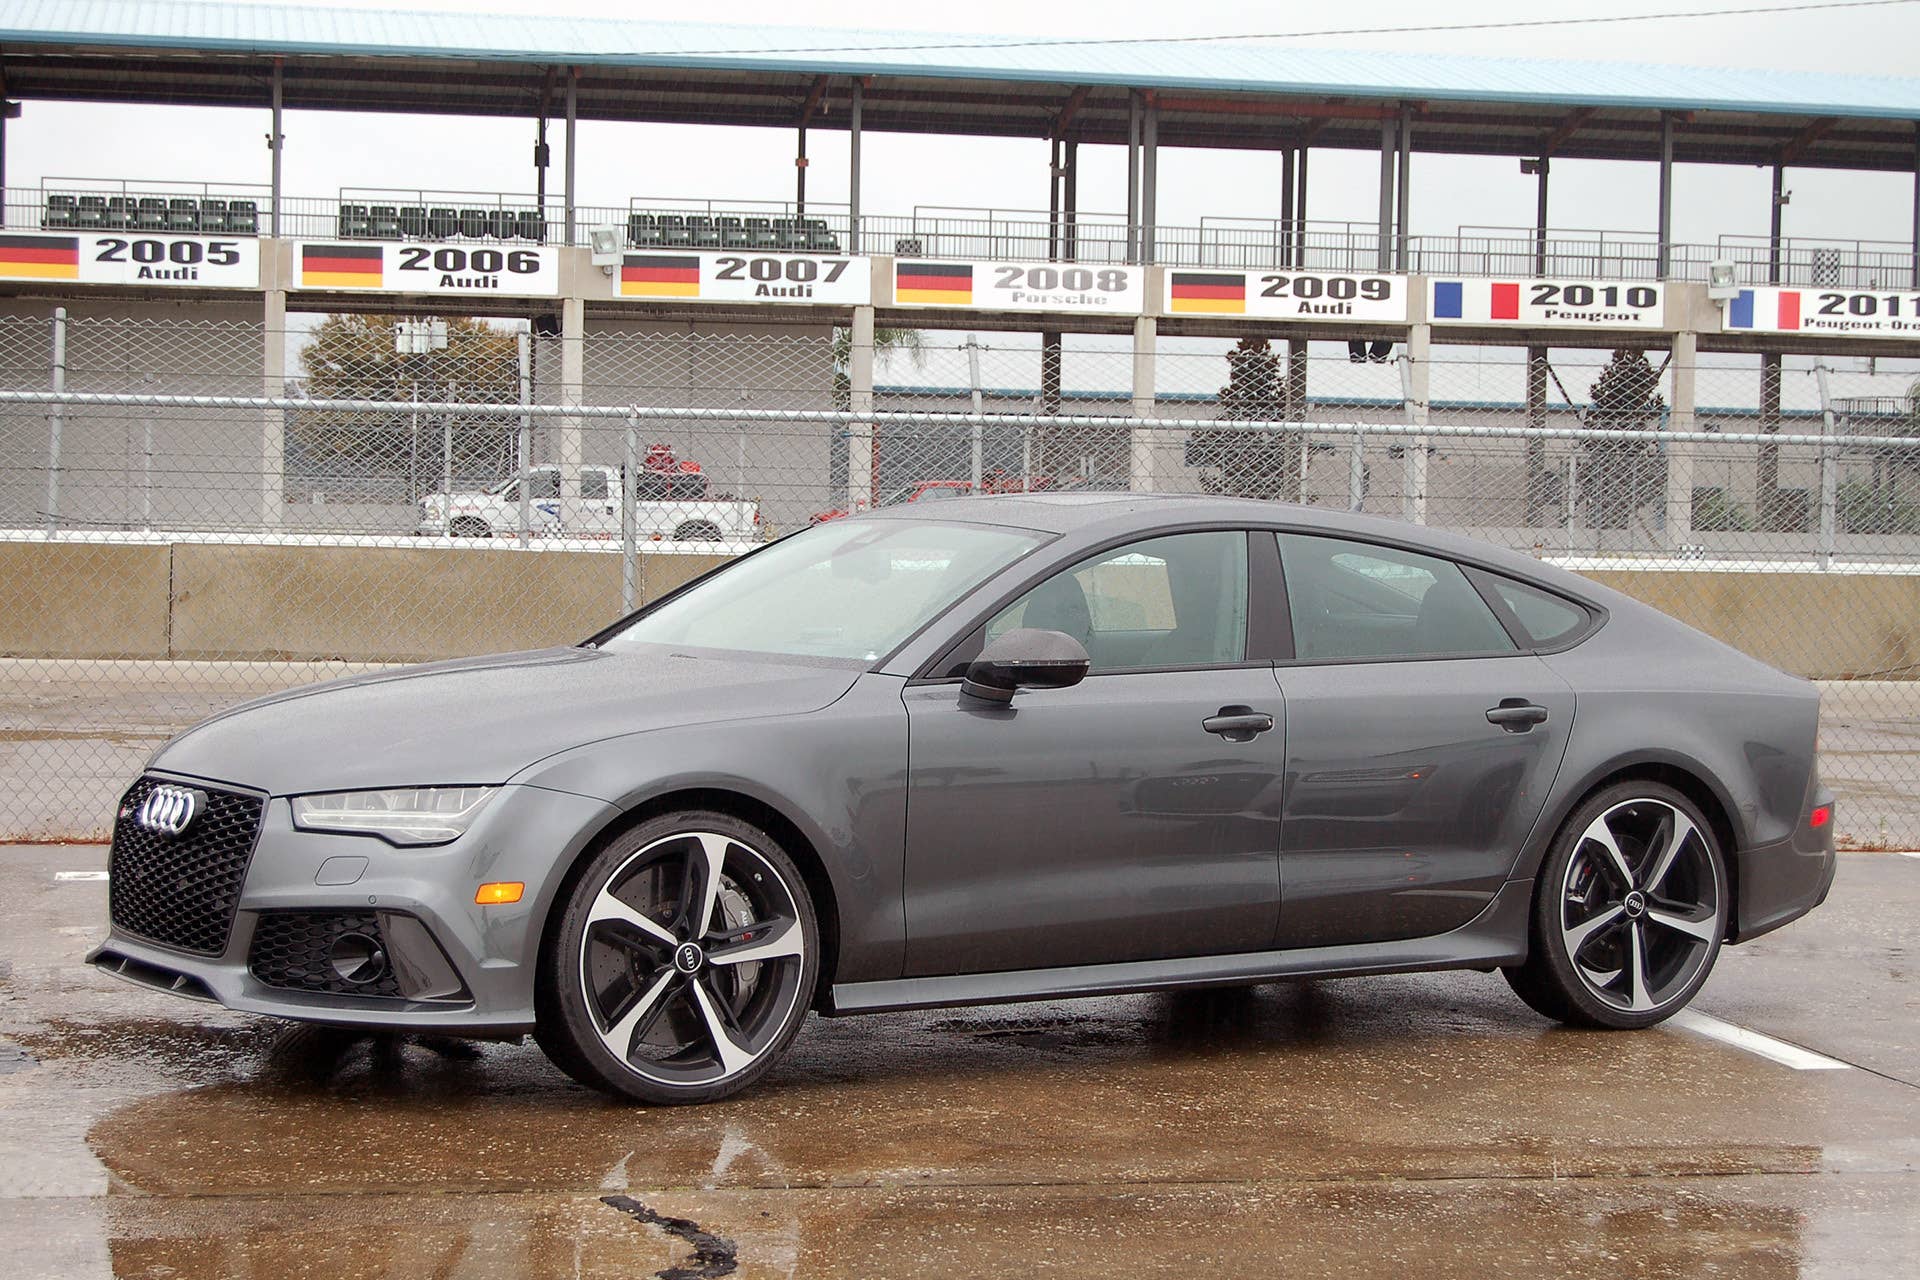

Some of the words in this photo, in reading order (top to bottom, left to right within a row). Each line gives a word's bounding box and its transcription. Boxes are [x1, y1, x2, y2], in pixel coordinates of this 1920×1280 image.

[95, 238, 241, 266] 2005
[399, 247, 541, 274] 2006
[137, 266, 198, 280] Audi
[439, 274, 499, 289] Audi
[715, 257, 850, 283] 2007
[993, 265, 1129, 292] 2008
[755, 284, 813, 298] Audi
[1012, 290, 1108, 305] Porsche
[1260, 275, 1391, 301] 2009
[1530, 284, 1658, 308] 2010
[1297, 301, 1352, 315] Audi
[1544, 309, 1641, 322] Peugeot
[1818, 293, 1920, 317] 2011
